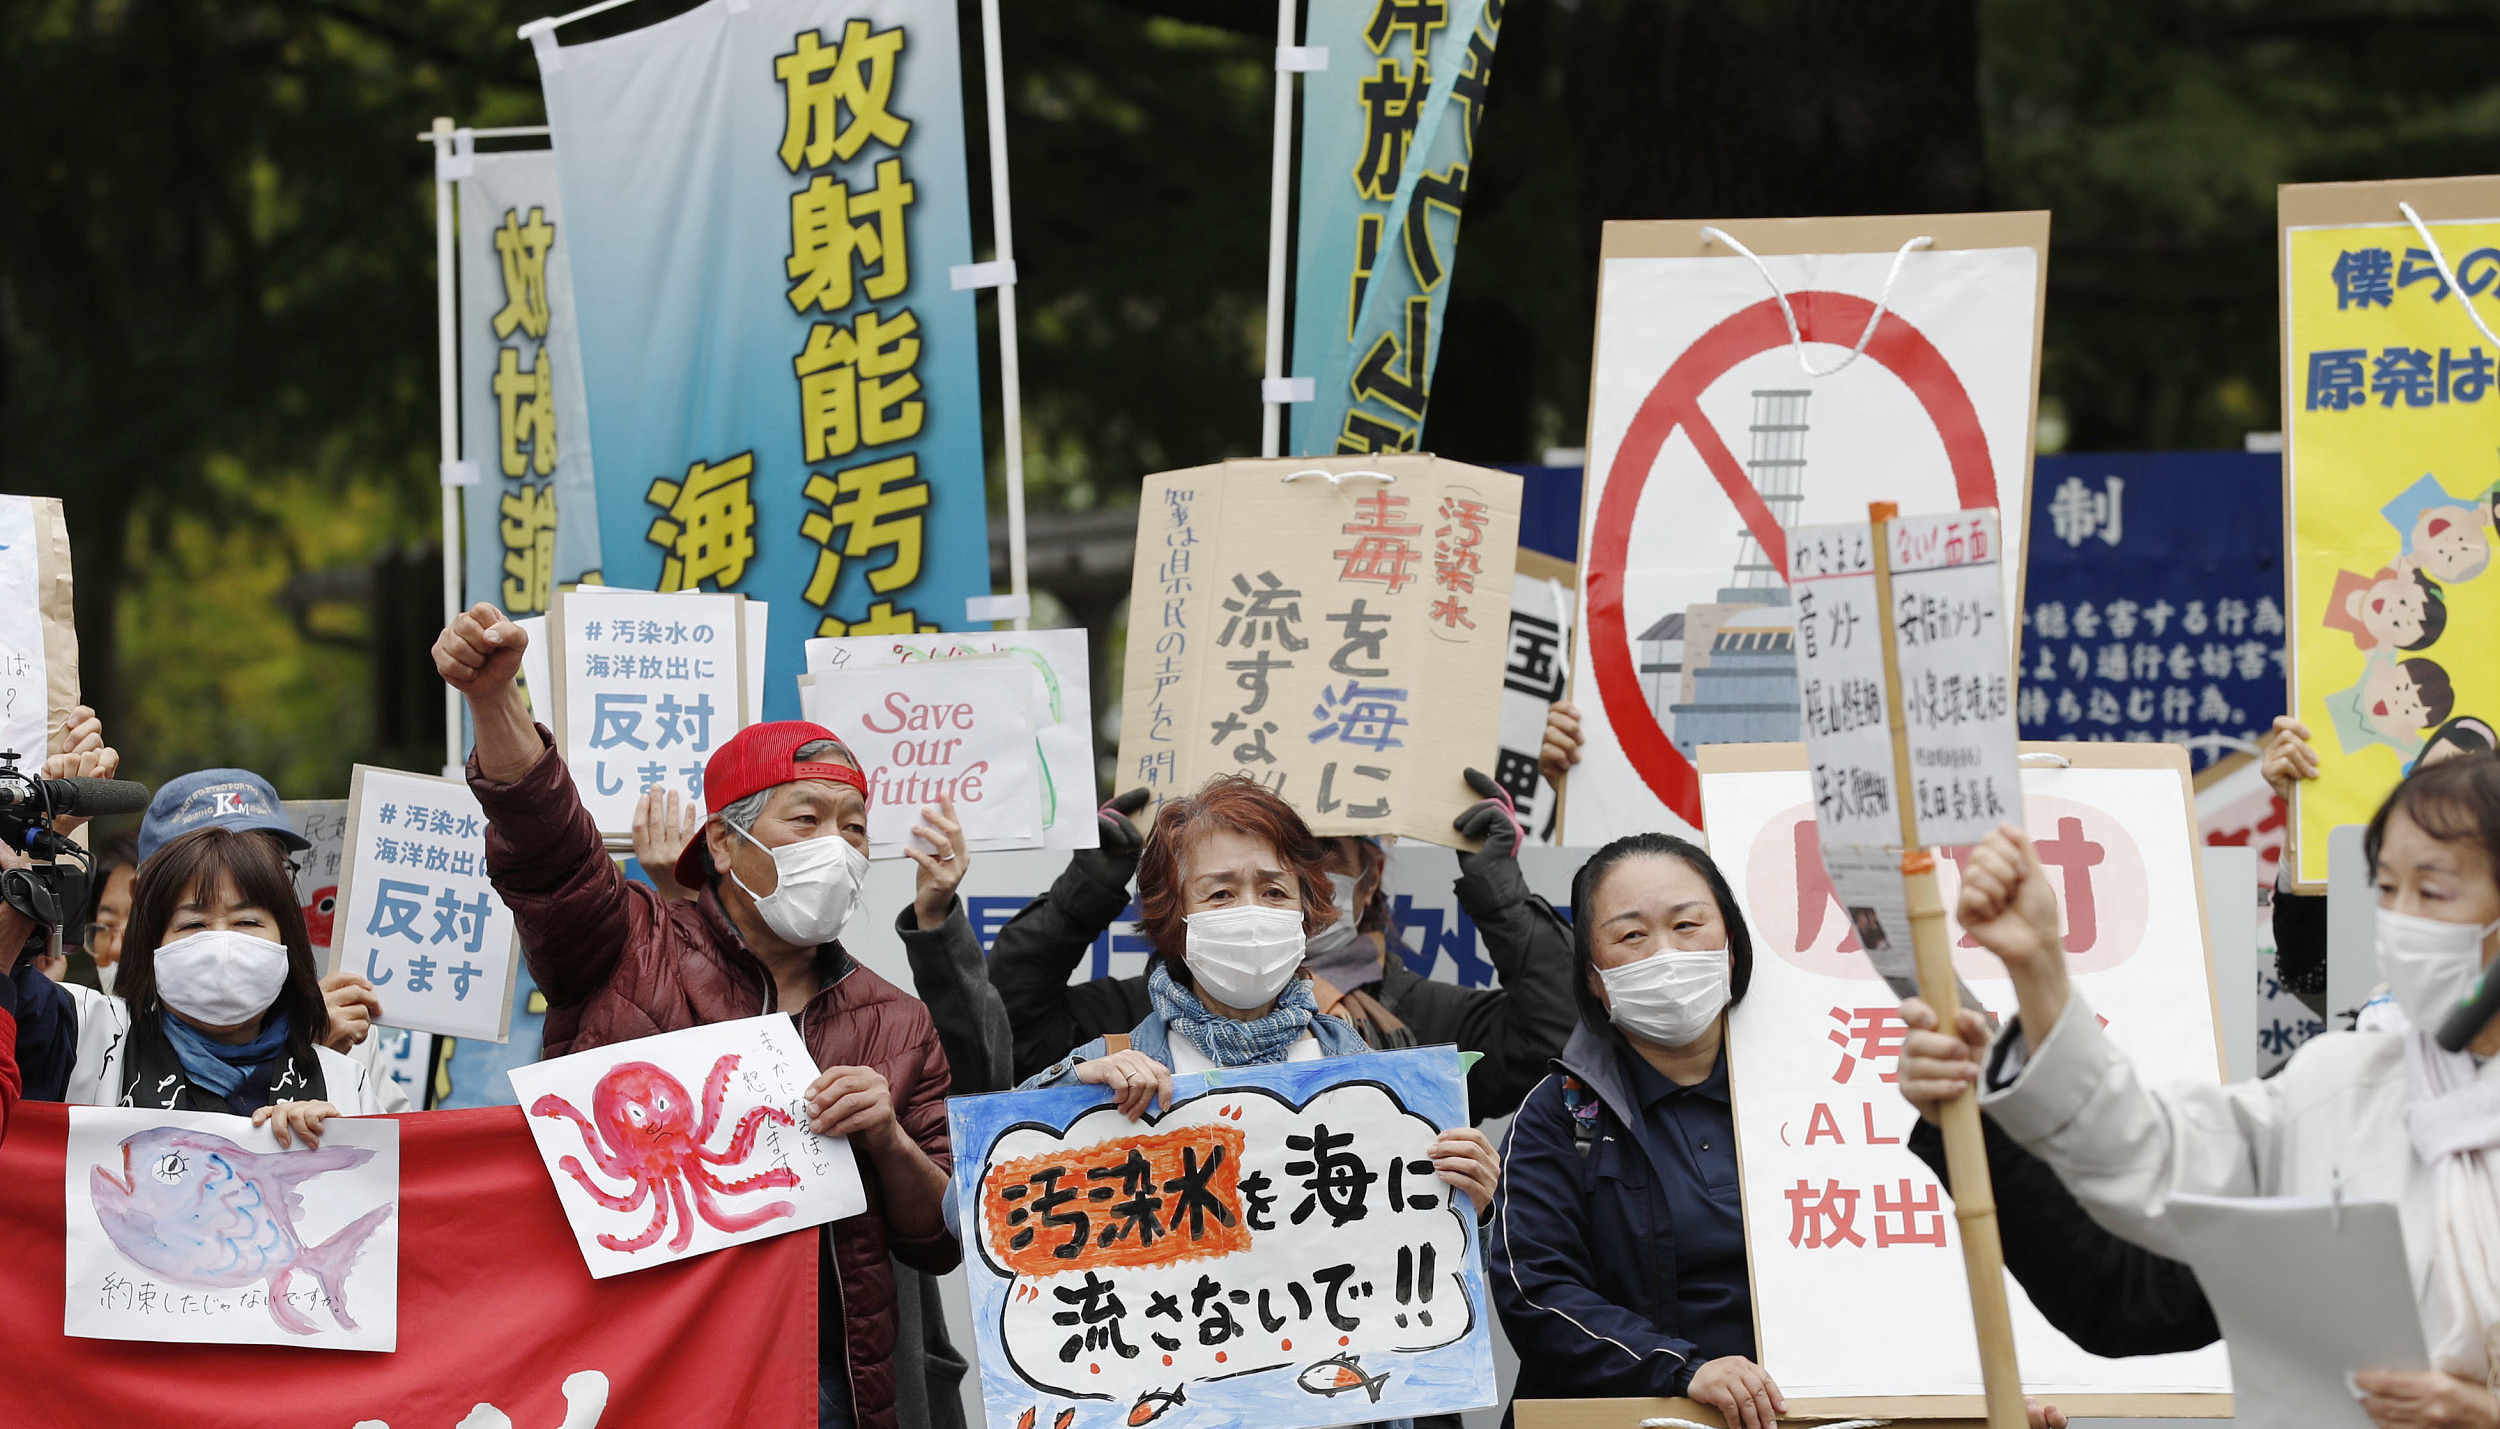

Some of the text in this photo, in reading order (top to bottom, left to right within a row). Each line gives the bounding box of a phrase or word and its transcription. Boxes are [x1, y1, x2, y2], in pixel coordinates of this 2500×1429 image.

[774, 19, 940, 638] 放射能汚
[585, 654, 715, 680] 海洋放出に
[1308, 489, 1422, 819] 毒を海に
[589, 693, 715, 753] 反対
[862, 692, 975, 734] Save
[892, 738, 963, 767] our
[595, 760, 705, 800] します
[866, 760, 989, 814] future
[403, 804, 490, 839] 汚染水
[366, 878, 493, 953] 反対
[366, 947, 484, 1002] します
[1002, 1123, 1438, 1259] 汚染水を海に
[1784, 1177, 1947, 1249] 放出
[100, 1271, 343, 1315] 約束したじゃないですか。
